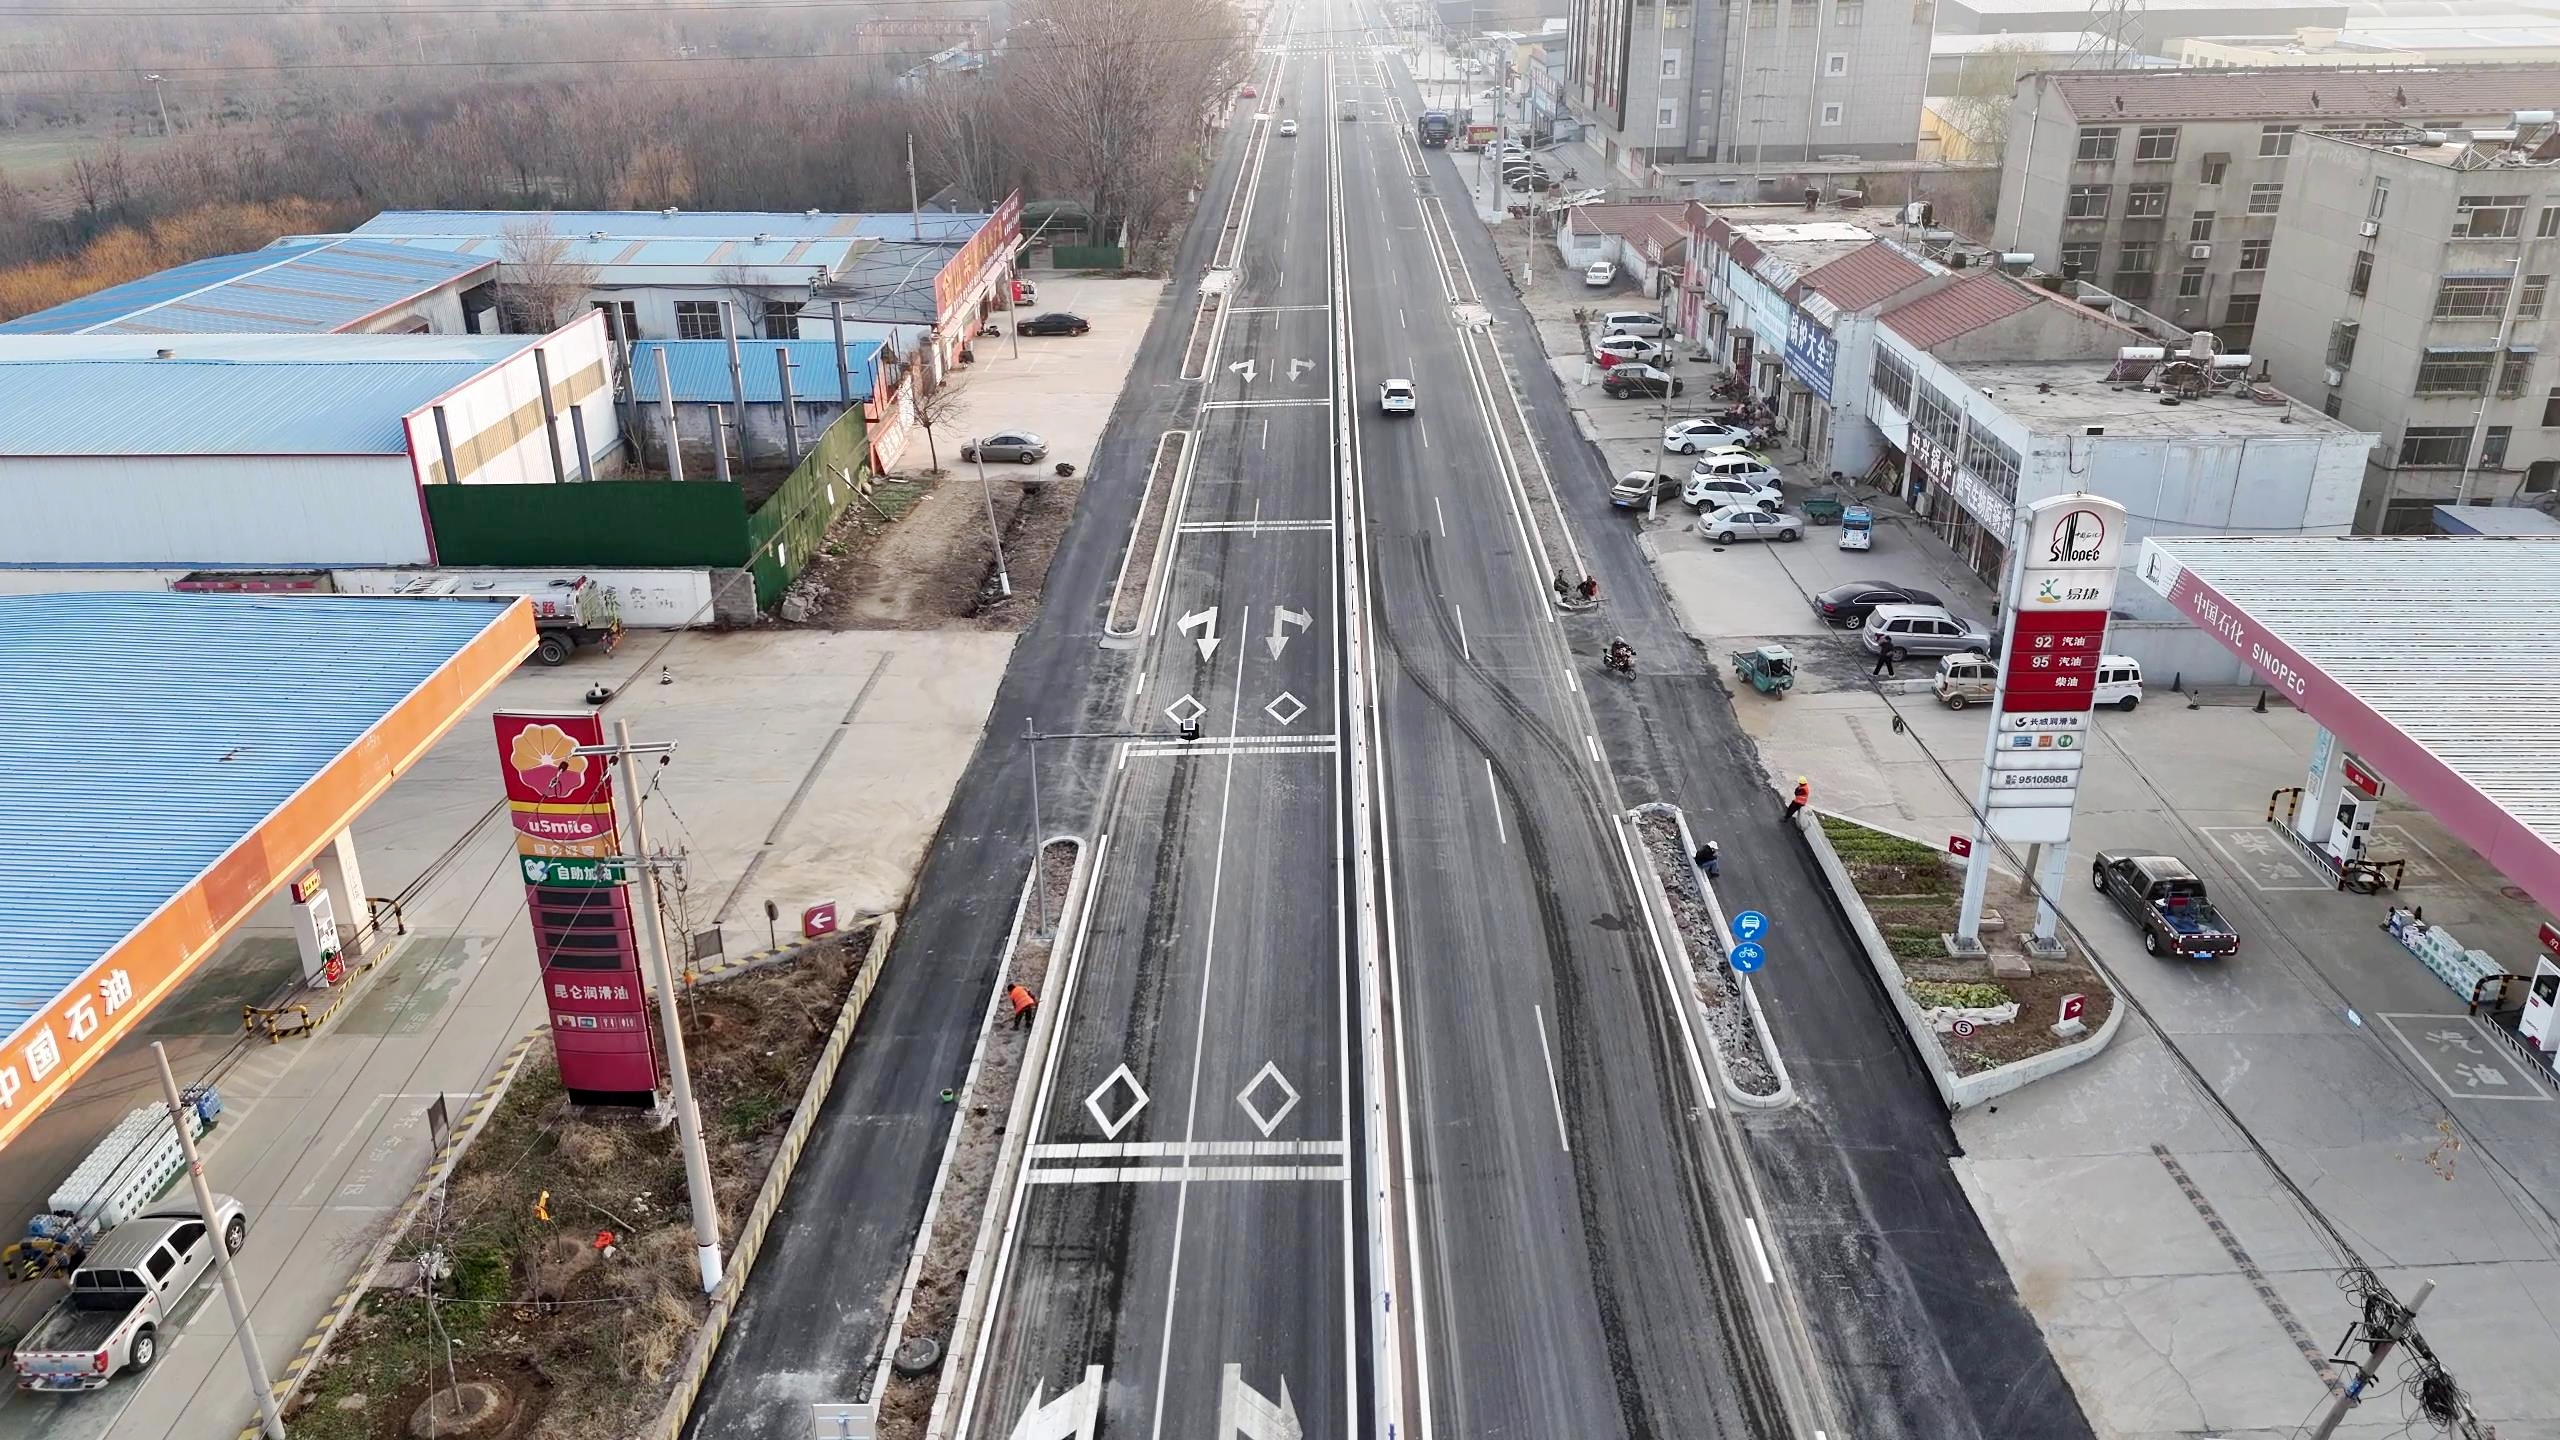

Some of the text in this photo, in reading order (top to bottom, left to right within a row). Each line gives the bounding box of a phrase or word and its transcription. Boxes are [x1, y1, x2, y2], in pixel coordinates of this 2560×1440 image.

[1789, 312, 1828, 369] 锅炉大全
[1911, 429, 1953, 483] 中兴锅炉
[2067, 587, 2099, 600] 易捷
[2194, 591, 2245, 648] 中国石化
[2034, 636, 2085, 648] 92 汽油
[2032, 656, 2082, 668] 95 汽油
[2252, 643, 2306, 696] SINOPEC
[2055, 676, 2079, 687] 柴油
[554, 983, 629, 1000] 昆仑润滑油
[1959, 1023, 1969, 1033] 5
[0, 968, 133, 1109] 中国石油
